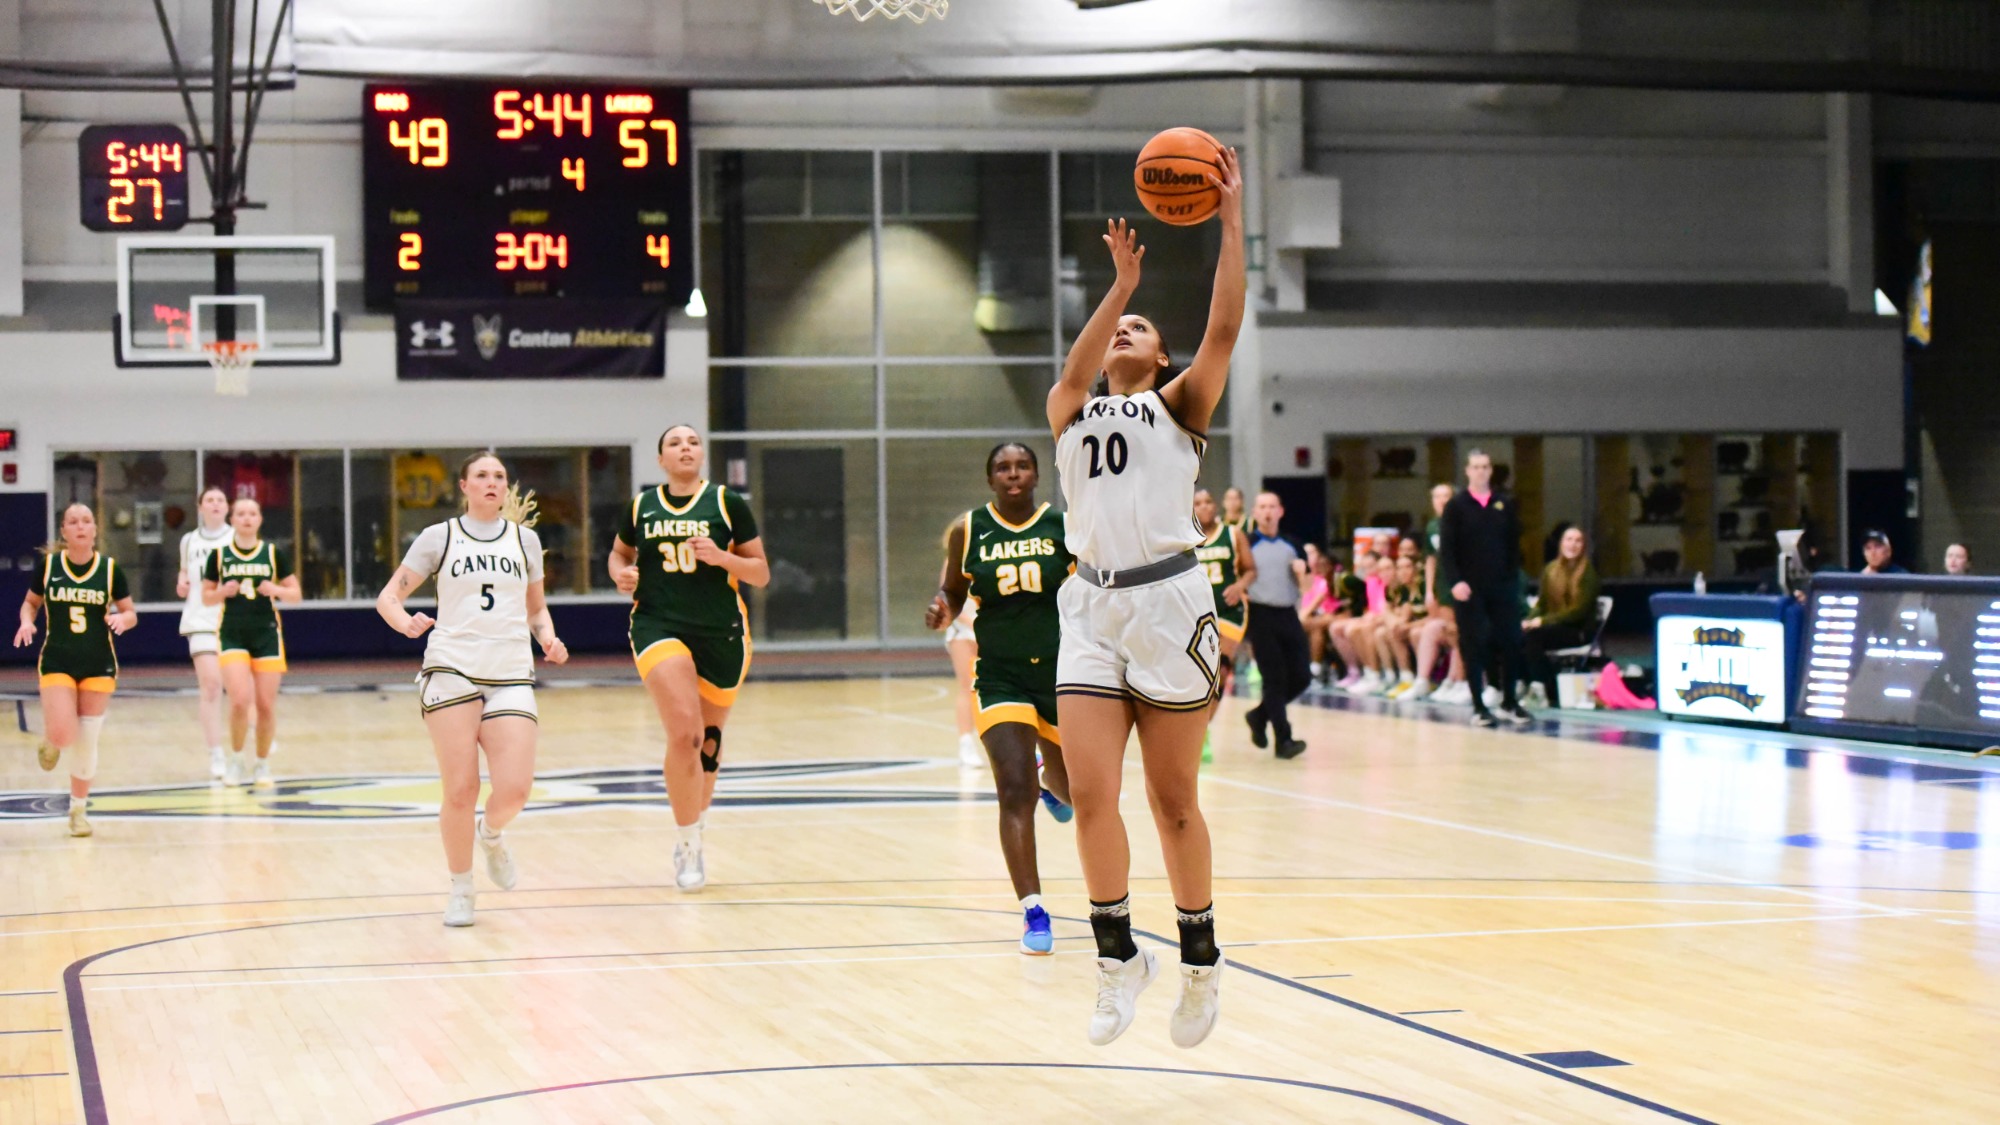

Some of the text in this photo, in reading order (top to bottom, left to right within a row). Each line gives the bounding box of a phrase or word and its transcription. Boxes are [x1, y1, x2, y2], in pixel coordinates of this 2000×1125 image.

[494, 91, 592, 139] 5:44
[106, 141, 182, 175] 5:44
[389, 118, 448, 167] 49
[619, 119, 677, 168] 57
[561, 157, 585, 192] 4
[1142, 167, 1204, 185] Wilson
[107, 178, 163, 223] 27
[398, 232, 422, 270] 2
[646, 234, 670, 269] 4
[508, 328, 654, 348] Canton Athletics
[1082, 432, 1128, 479] 20
[644, 519, 710, 539] LAKERS
[658, 542, 697, 573] 30
[979, 537, 1055, 562] LAKERS
[222, 563, 271, 577] LAKERS
[451, 554, 522, 580] CANTON
[995, 561, 1042, 596] 20
[49, 587, 105, 604] LAKERS
[240, 577, 256, 600] 4
[480, 583, 495, 611] 5
[69, 606, 87, 634] 5
